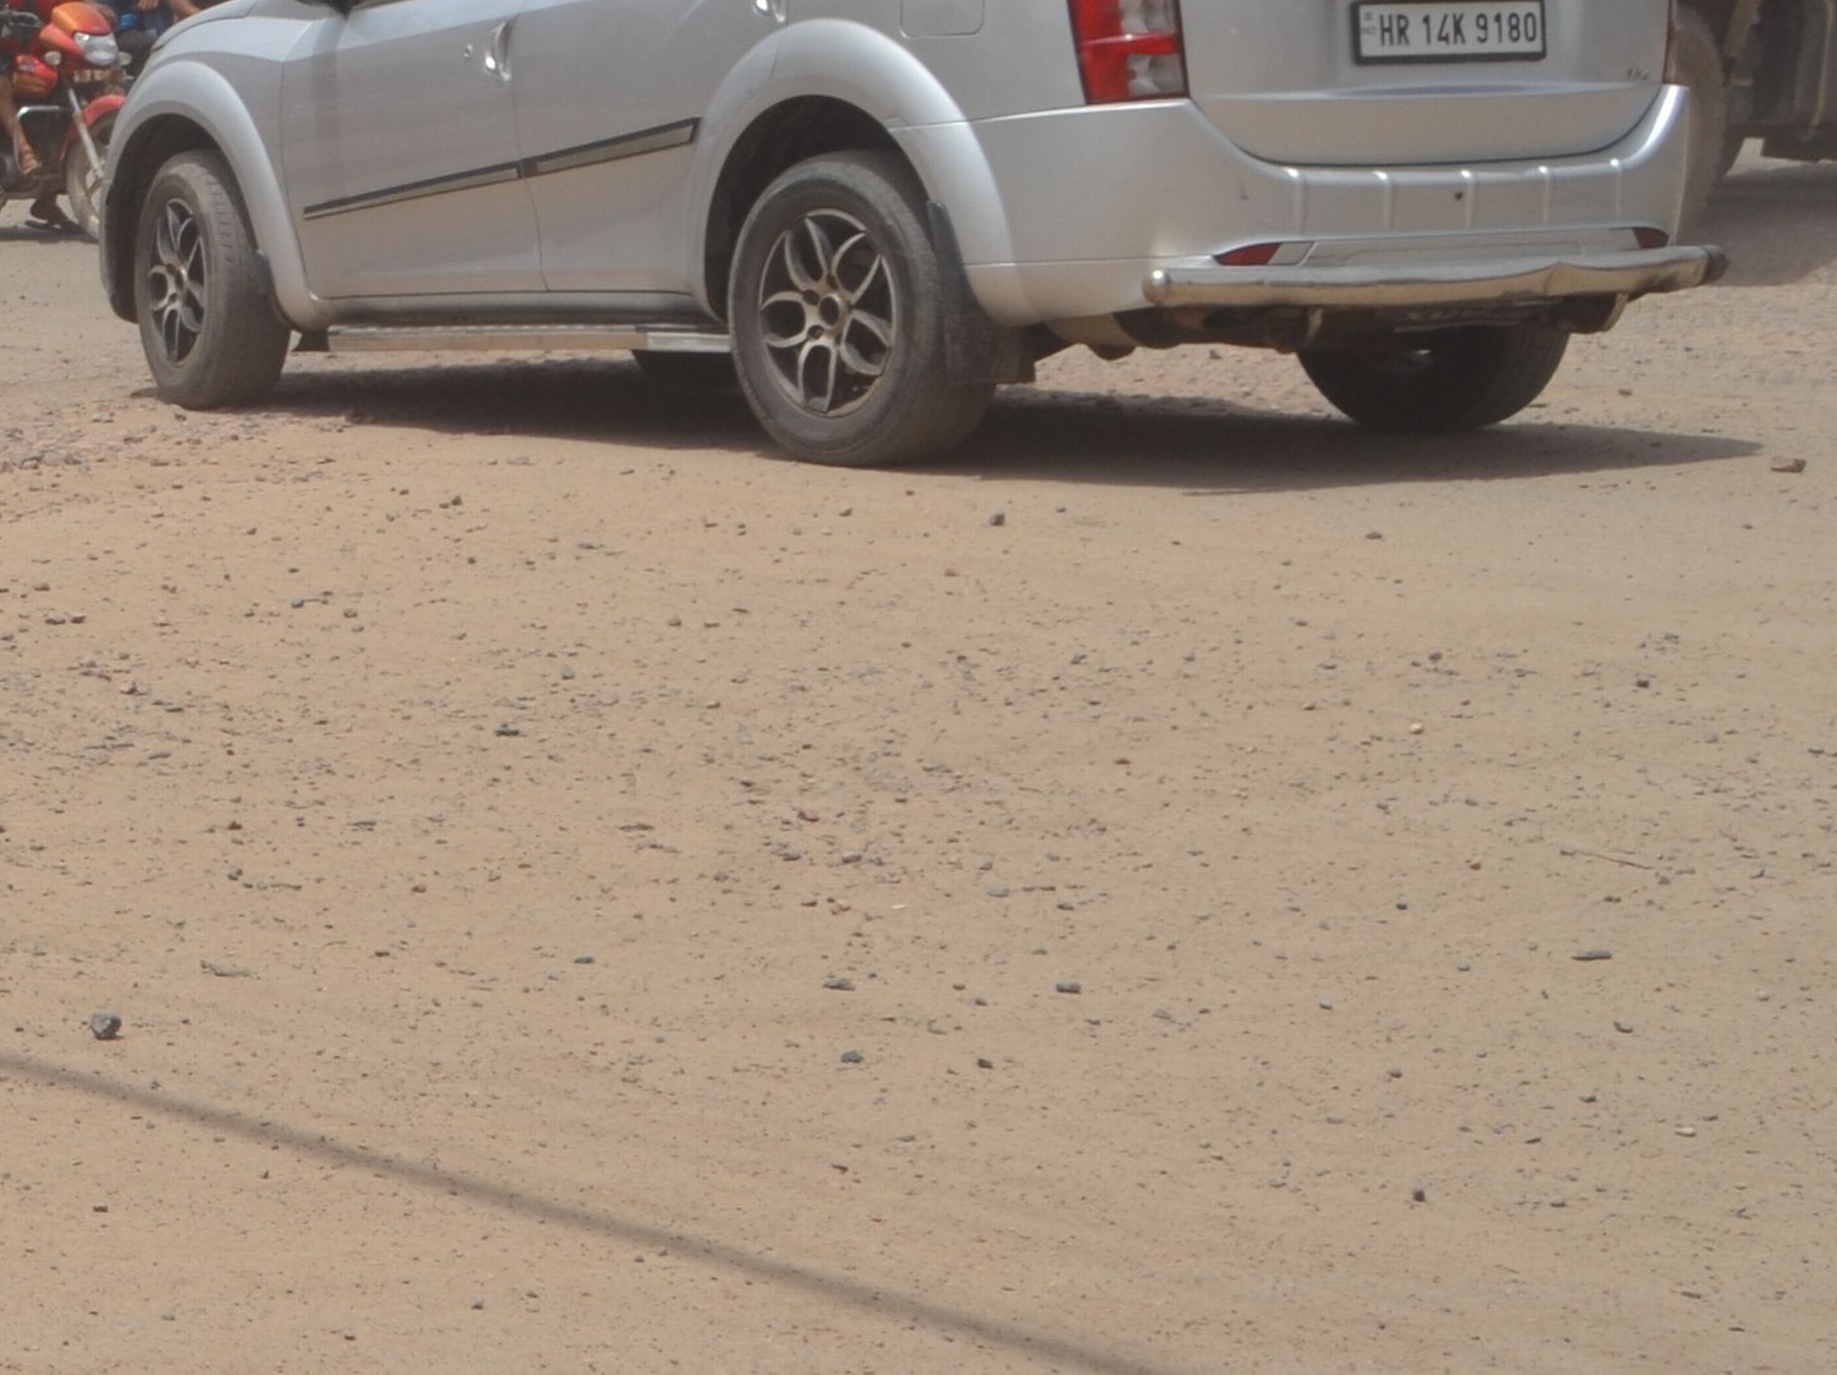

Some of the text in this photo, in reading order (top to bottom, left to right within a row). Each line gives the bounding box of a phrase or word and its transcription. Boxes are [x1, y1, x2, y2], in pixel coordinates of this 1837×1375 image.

[1379, 13, 1410, 46] HR
[1422, 12, 1467, 47] 14K
[1475, 11, 1538, 44] 9180
